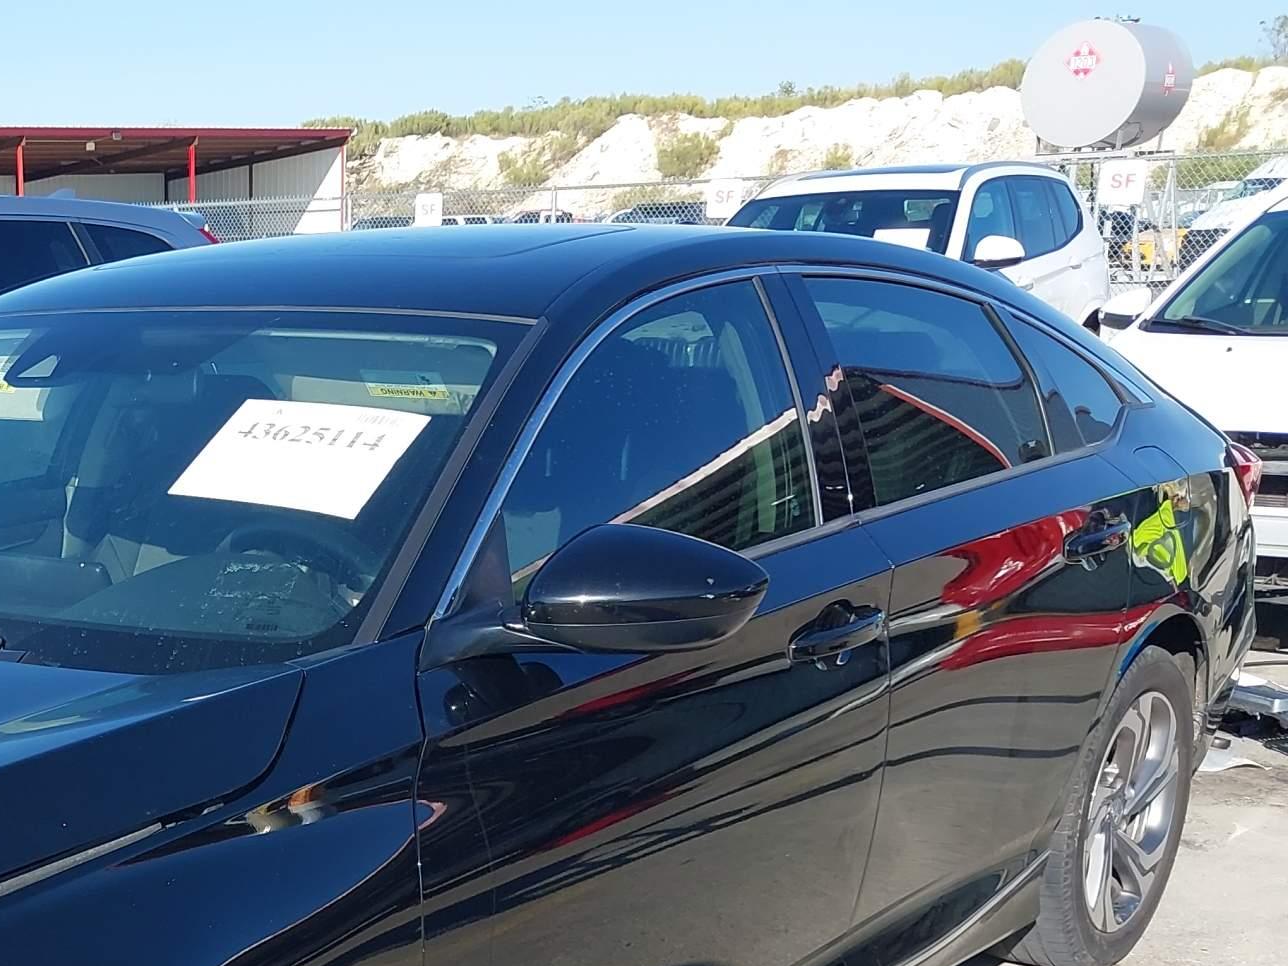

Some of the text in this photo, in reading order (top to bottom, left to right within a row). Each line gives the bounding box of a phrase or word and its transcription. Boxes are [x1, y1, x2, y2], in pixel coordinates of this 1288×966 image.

[1110, 173, 1136, 188] SF
[714, 190, 735, 204] SF
[422, 203, 437, 215] SF
[380, 388, 425, 397] WARNING
[238, 422, 386, 451] 43625114
